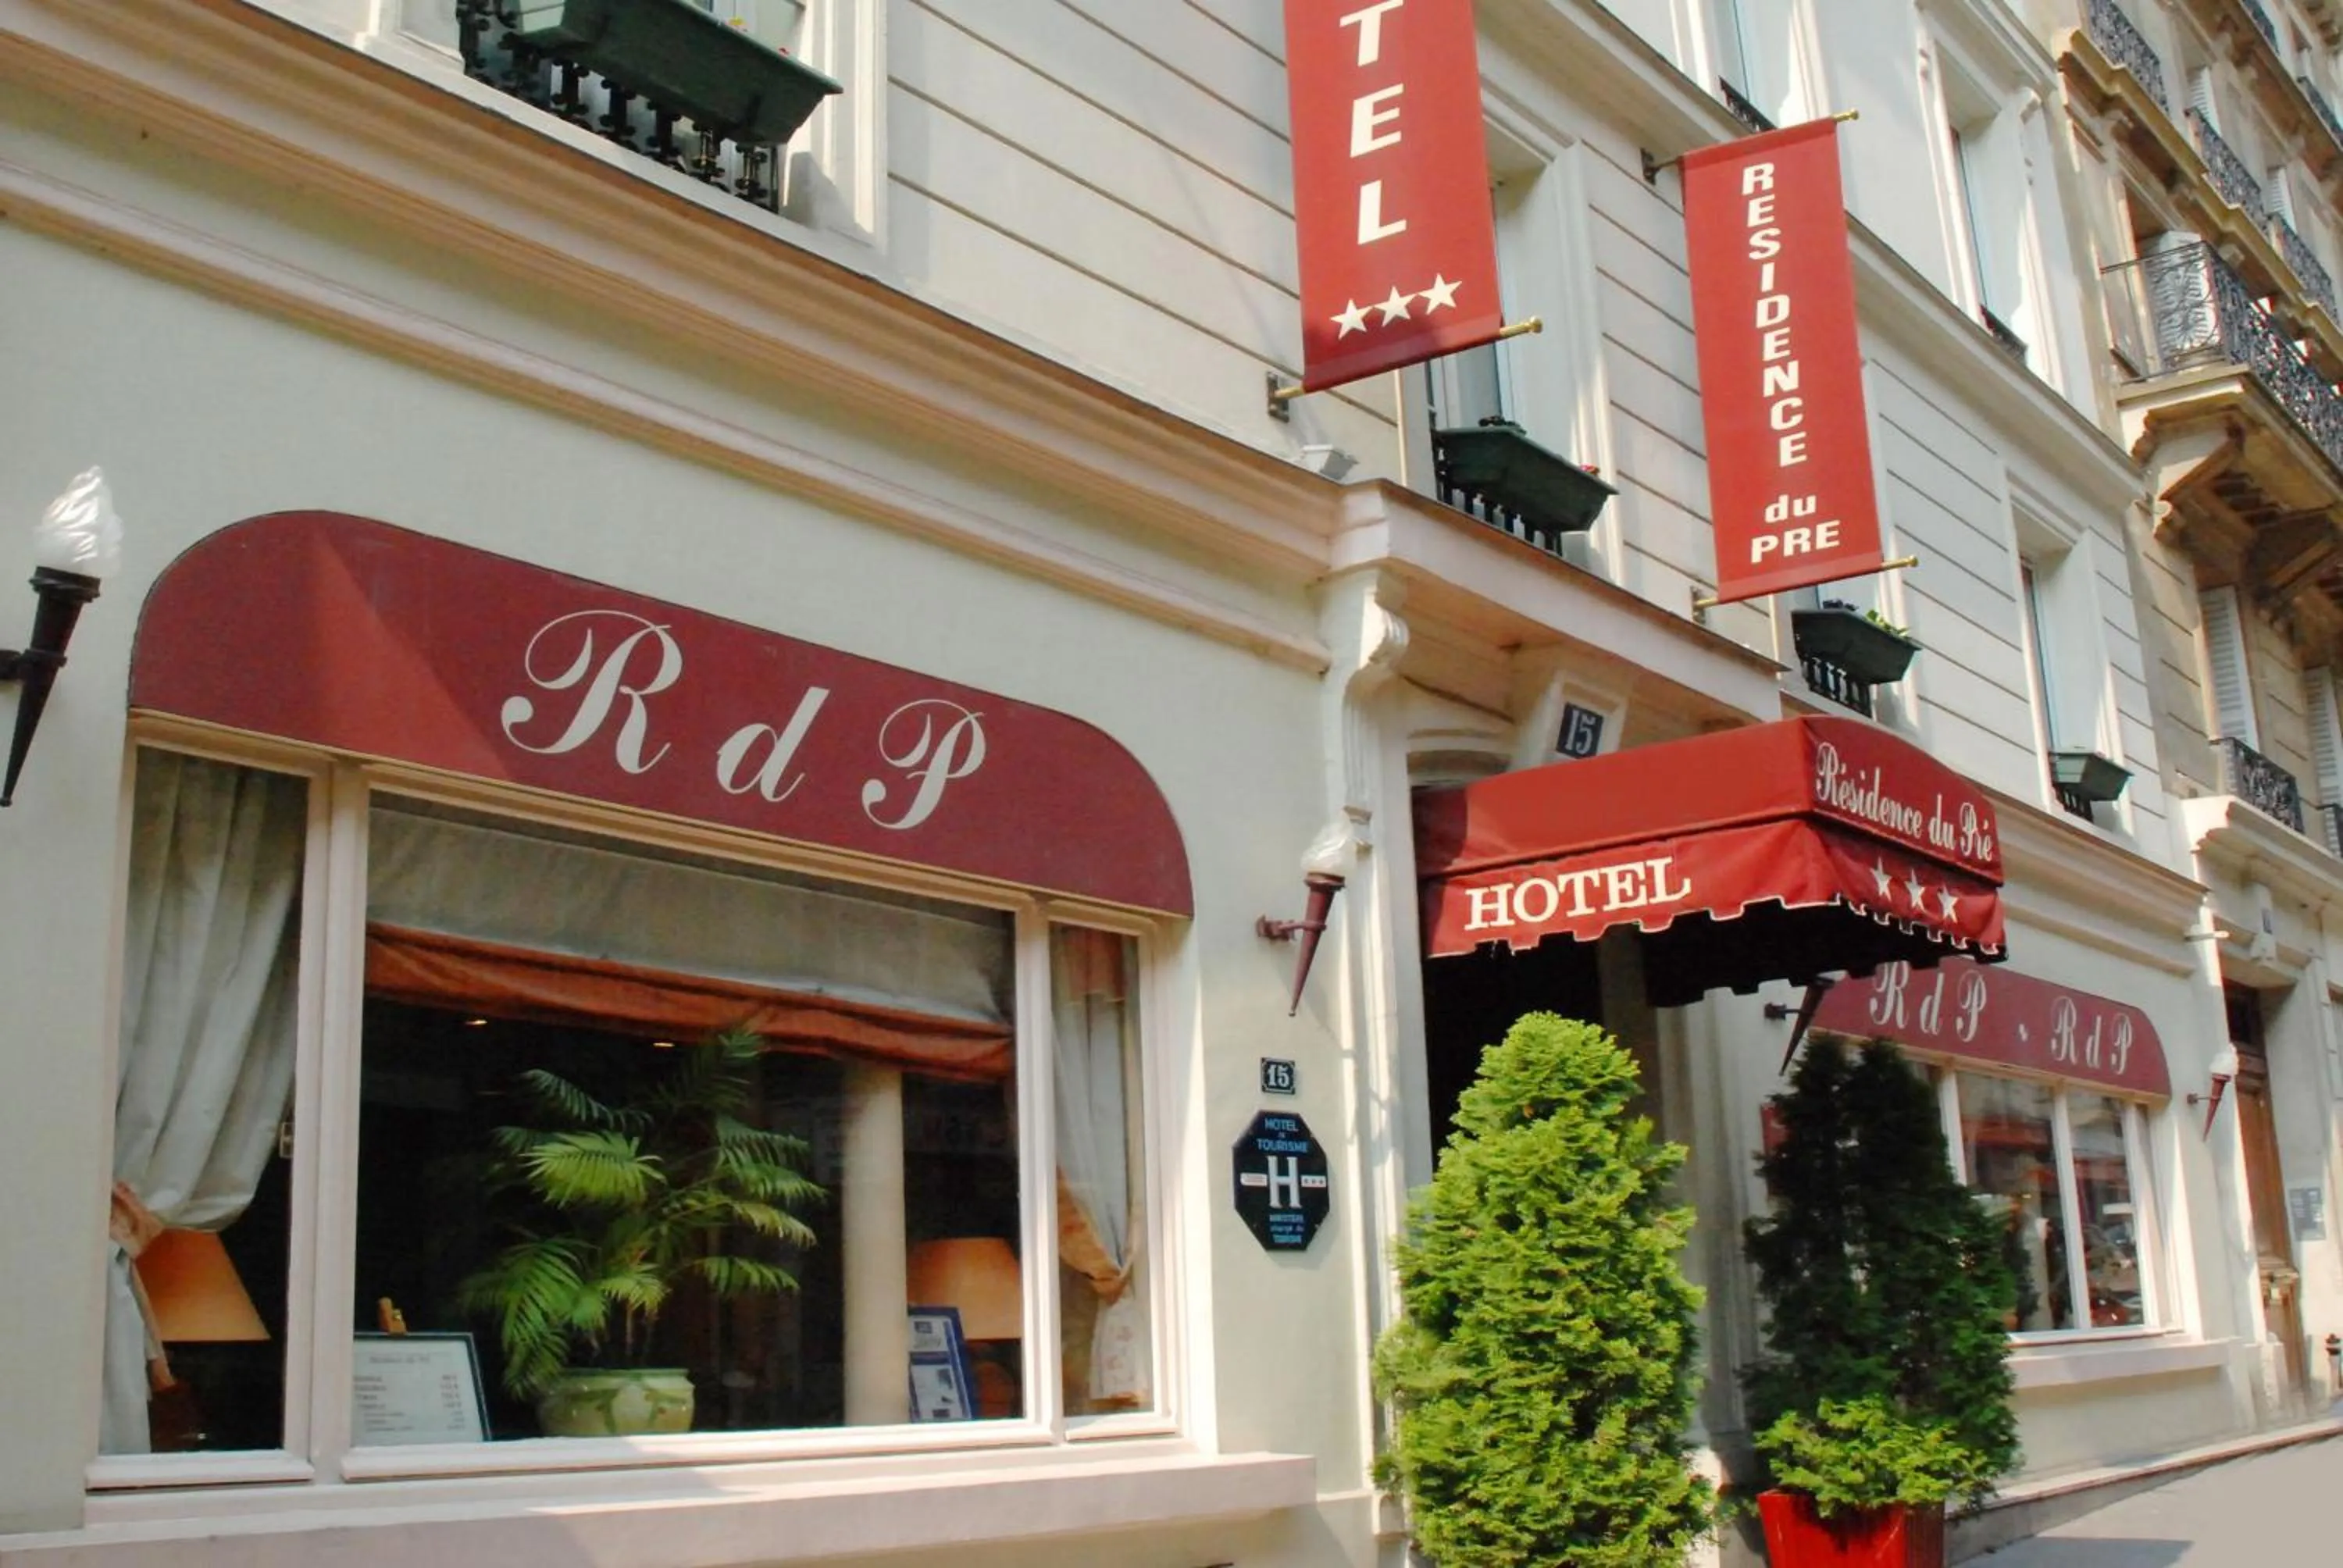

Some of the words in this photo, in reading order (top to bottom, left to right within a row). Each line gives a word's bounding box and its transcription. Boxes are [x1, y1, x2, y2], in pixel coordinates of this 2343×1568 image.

[1339, 0, 1407, 245] TEL
[1742, 162, 1807, 468] RESIDENCE
[1763, 493, 1817, 524] du
[1750, 520, 1841, 564] PRE
[1565, 710, 1597, 755] 15
[1816, 742, 1923, 839] Résidence
[1928, 793, 1956, 850] du
[1960, 802, 1992, 862] Pré
[1464, 856, 1692, 930] HOTEL
[1268, 1064, 1290, 1088] 15
[1257, 1138, 1308, 1153] TOURISME
[1264, 1117, 1299, 1131] HOTEL
[1267, 1156, 1302, 1210] H
